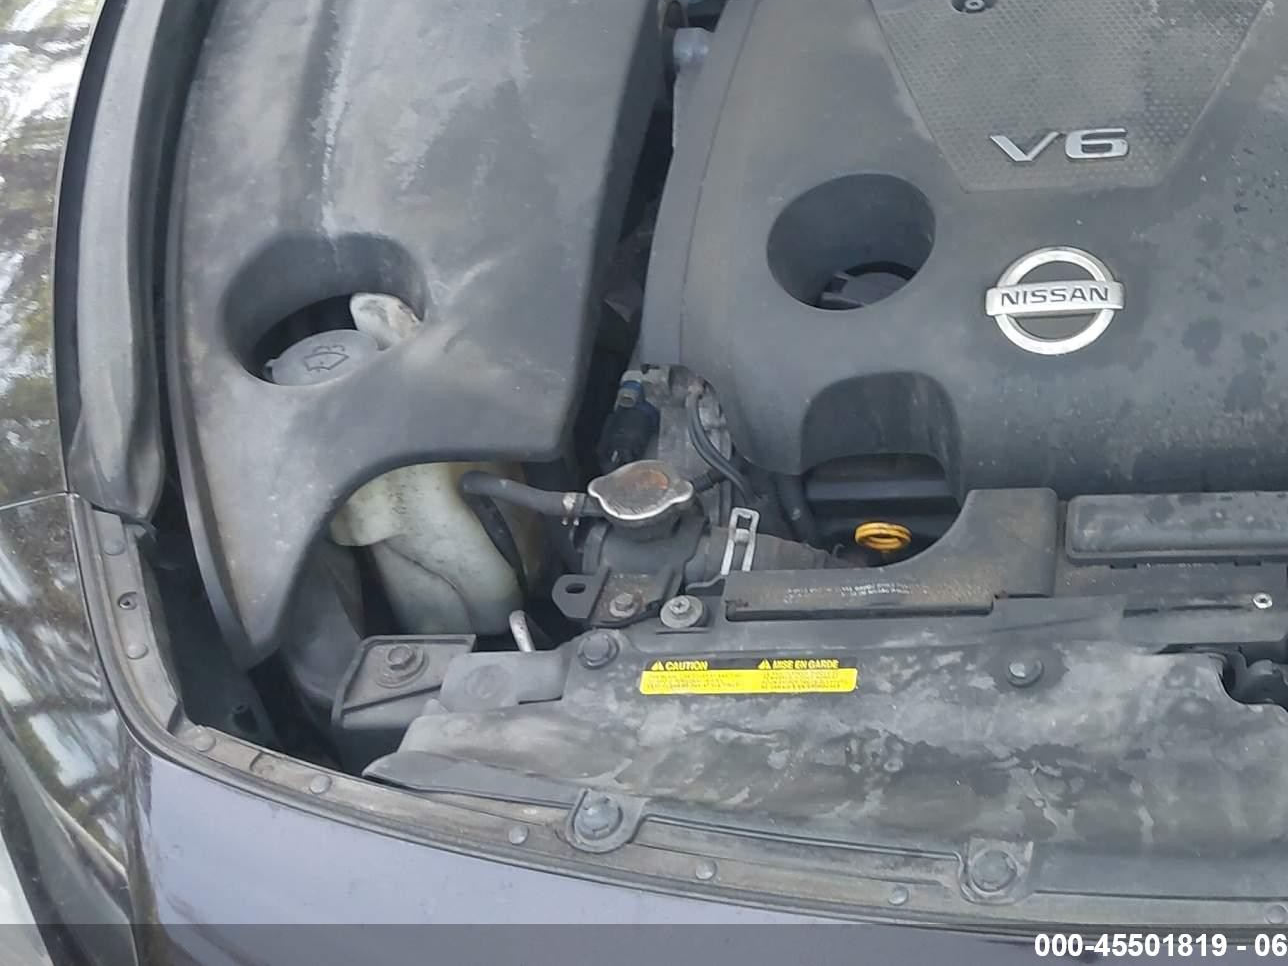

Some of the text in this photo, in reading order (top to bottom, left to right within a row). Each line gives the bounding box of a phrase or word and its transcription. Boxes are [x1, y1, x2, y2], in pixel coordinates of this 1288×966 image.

[989, 128, 1129, 162] V6
[1001, 286, 1109, 307] NISSAN
[665, 660, 709, 671] CAUTION
[808, 659, 840, 669] GARDE
